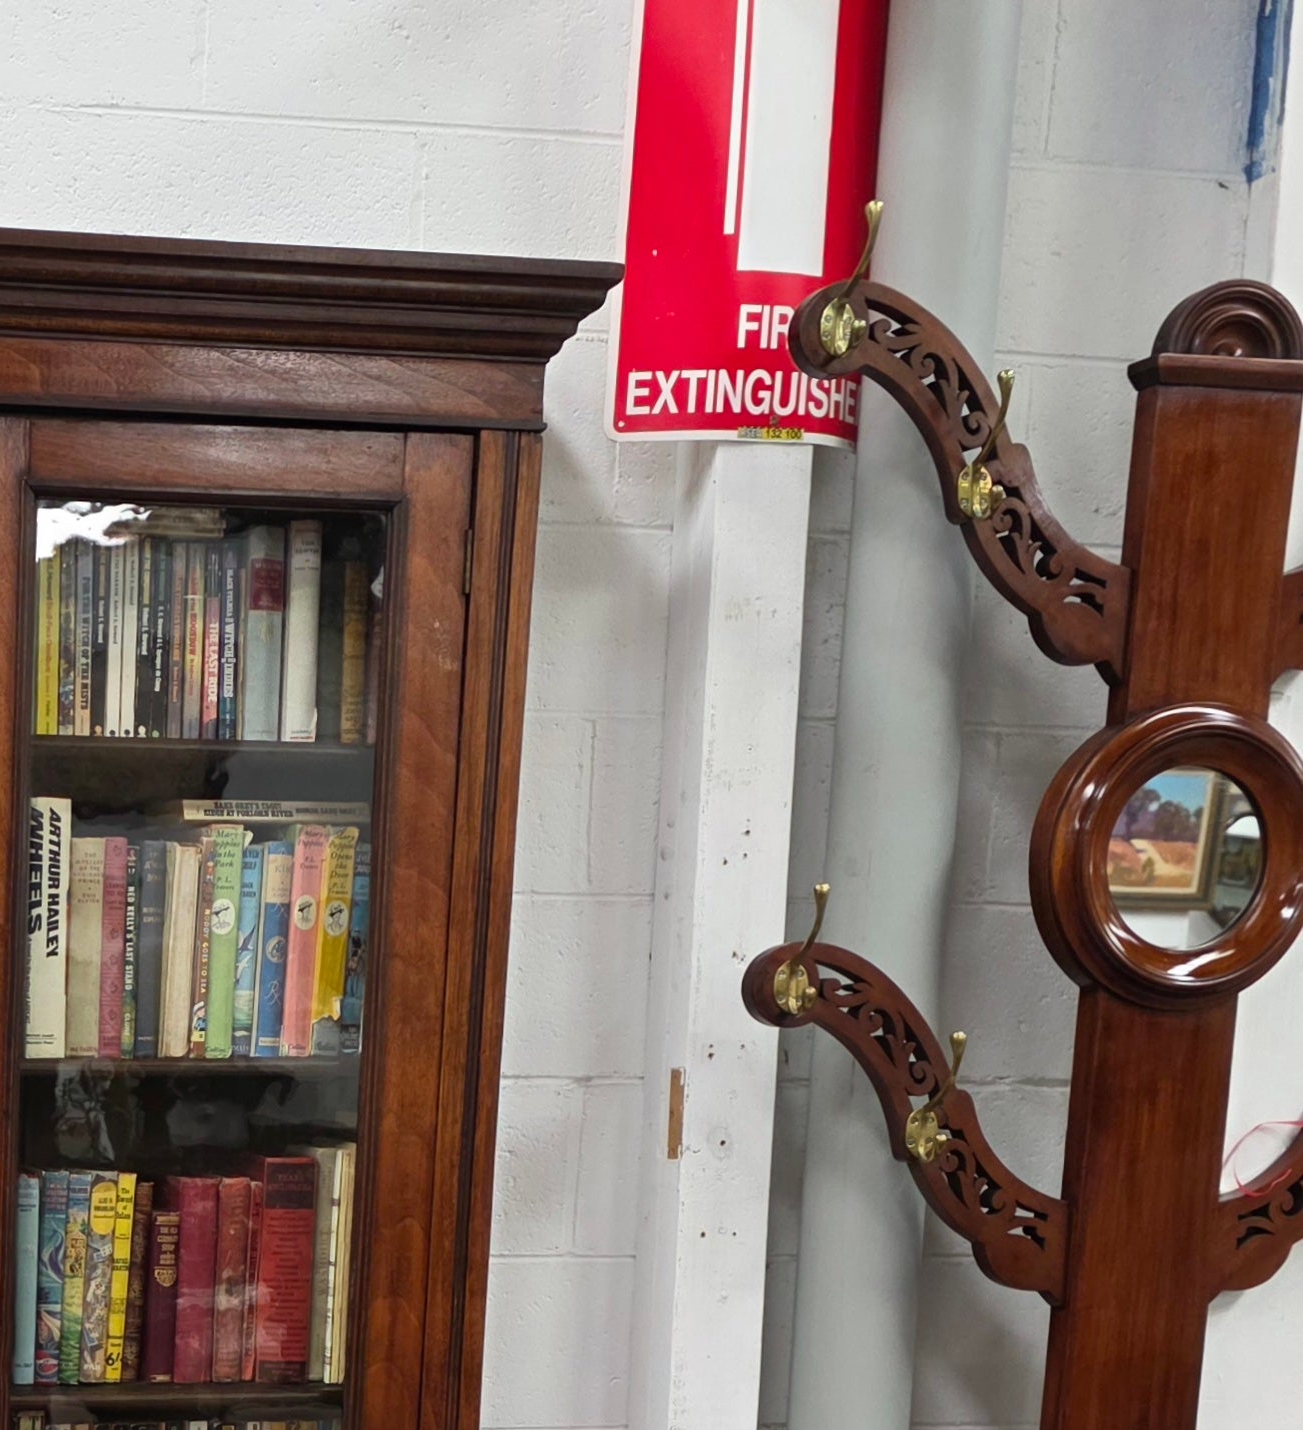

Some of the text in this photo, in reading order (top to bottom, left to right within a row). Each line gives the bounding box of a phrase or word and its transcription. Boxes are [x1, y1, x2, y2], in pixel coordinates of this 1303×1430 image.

[737, 304, 792, 349] FIR
[626, 368, 859, 425] EXTINGUISHE
[766, 428, 783, 439] 132
[786, 428, 803, 440] 100
[224, 622, 235, 658] WITCH
[80, 617, 89, 710] WITCH OF THE MISTS
[208, 622, 219, 703] THE LAST RIDE
[223, 663, 234, 698] INDIES
[271, 809, 294, 818] RIVER
[27, 807, 45, 935] WHEELS
[216, 859, 233, 867] Park
[330, 851, 353, 861] Opens
[46, 807, 63, 958] ARTHUR HAILEY
[330, 870, 349, 878] Door
[125, 886, 135, 990] NED KELLY'S LAST STAND
[203, 909, 211, 938] NODDY
[201, 966, 207, 976] TO
